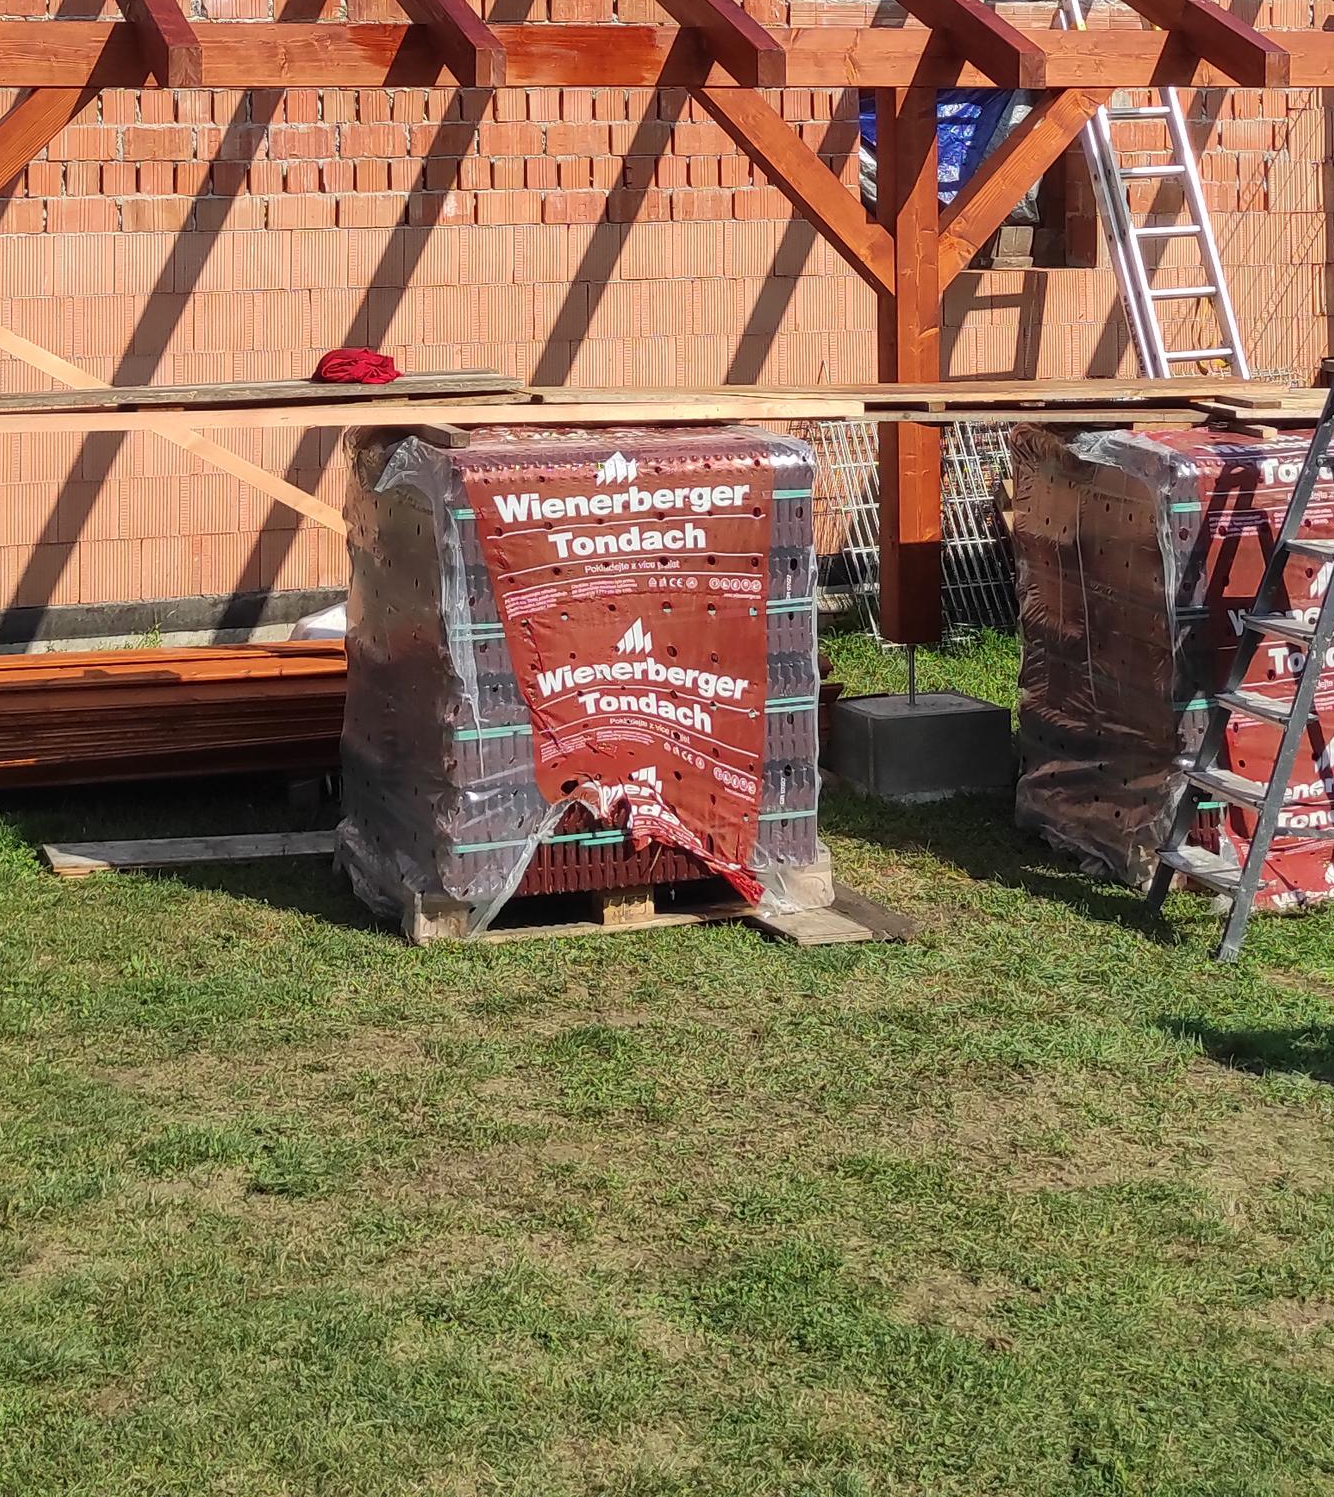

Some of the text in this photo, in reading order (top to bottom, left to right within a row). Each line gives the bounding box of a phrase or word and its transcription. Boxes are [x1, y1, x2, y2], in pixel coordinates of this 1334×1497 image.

[492, 484, 750, 524] Wienerberger
[548, 522, 707, 559] Tondach
[536, 657, 749, 700] Wienerberger
[578, 692, 712, 734] Tondach
